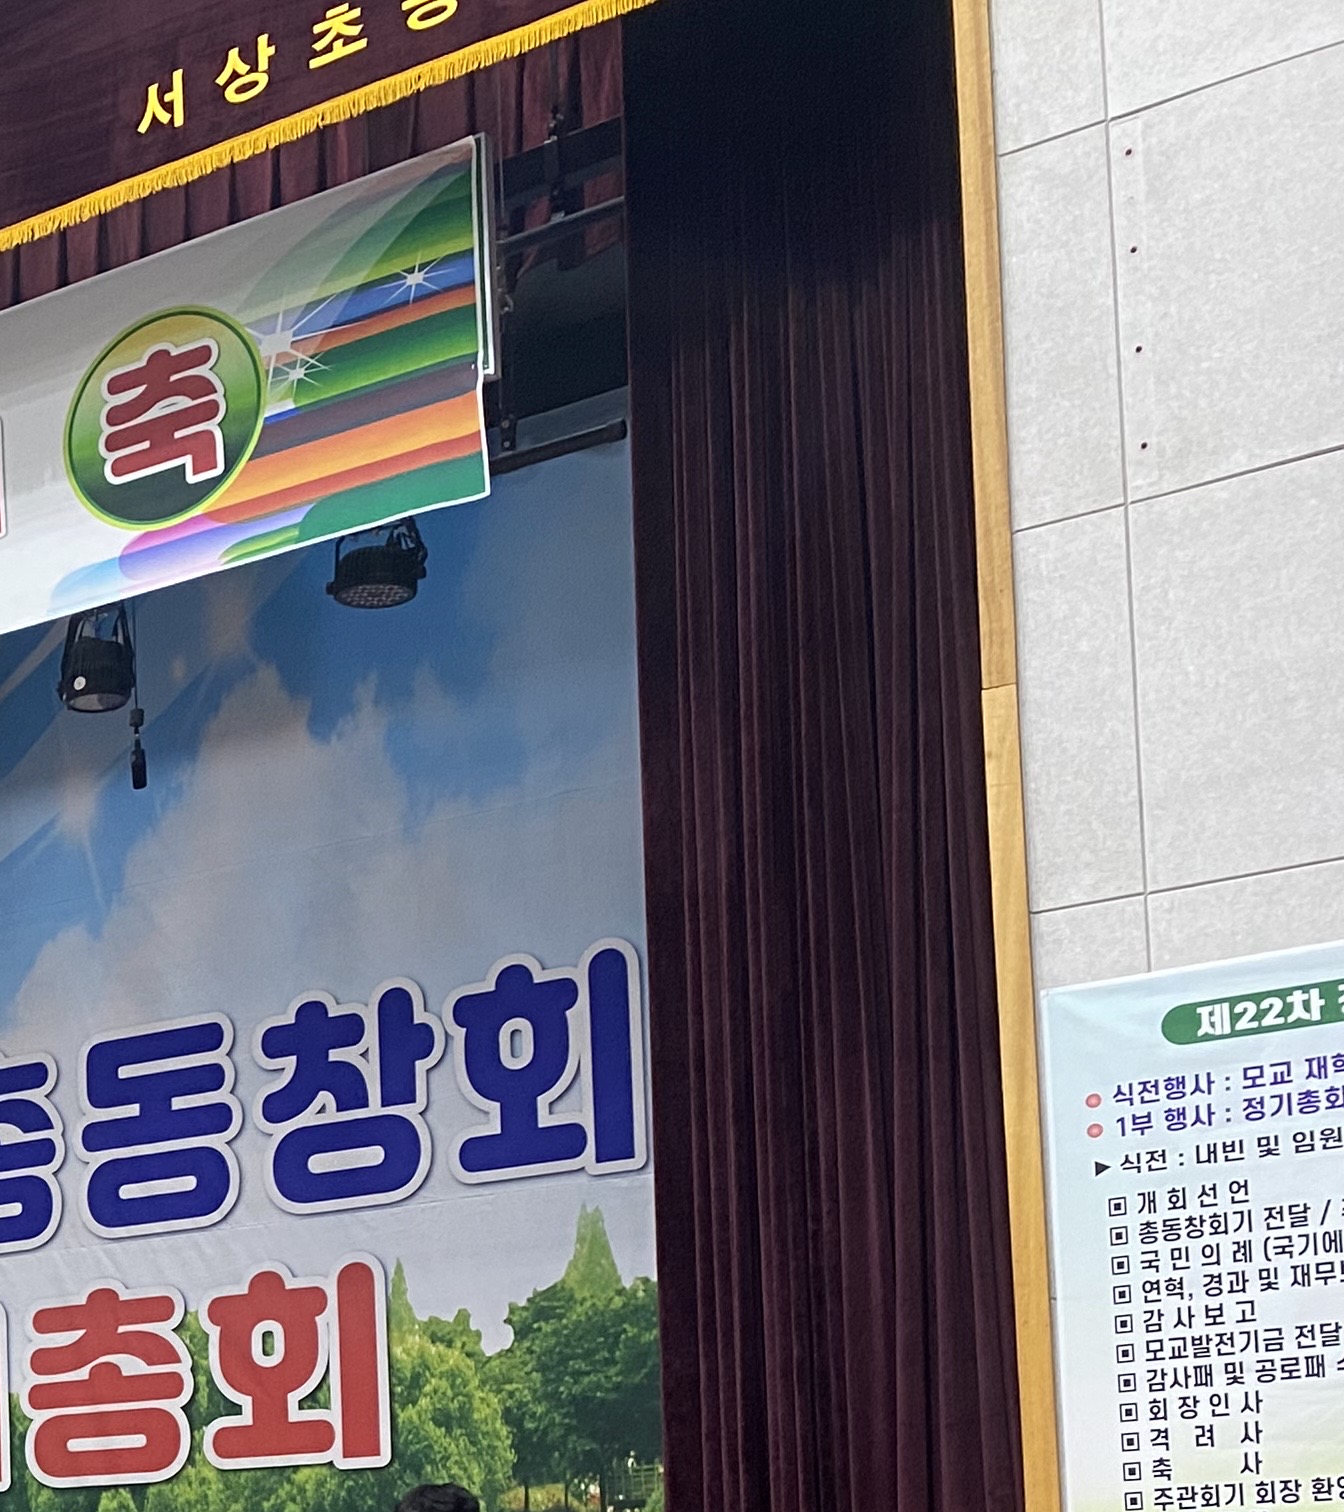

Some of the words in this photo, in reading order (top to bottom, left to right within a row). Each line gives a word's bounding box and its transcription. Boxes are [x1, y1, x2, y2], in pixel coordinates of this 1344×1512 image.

[100, 343, 224, 484] 축
[1196, 987, 1325, 1037] 제22차
[1113, 1072, 1215, 1106] 식전행사
[1242, 1061, 1293, 1089] 모교
[1116, 1111, 1153, 1137] 1부
[1164, 1103, 1215, 1131] 행사
[1120, 1149, 1167, 1173] 식전
[1195, 1139, 1245, 1164] 내빈
[1257, 1135, 1280, 1158] 및
[1293, 1126, 1344, 1154] 임원
[1139, 1209, 1252, 1245] 총동창회기
[1264, 1203, 1311, 1231] 전달
[1264, 1230, 1344, 1262] (국기에
[1142, 1276, 1193, 1303] 연혁,
[1203, 1270, 1249, 1297] 경과
[1259, 1267, 1279, 1292] 및
[1290, 1260, 1344, 1287] 재무
[1146, 1327, 1284, 1361] 모교발전기금
[1295, 1322, 1342, 1349] 전달
[1146, 1363, 1213, 1392] 감사패
[1224, 1361, 1245, 1386] 및
[1255, 1354, 1325, 1383] 공로패
[1154, 1482, 1244, 1511] 주관회기
[1255, 1479, 1302, 1504] 회장
